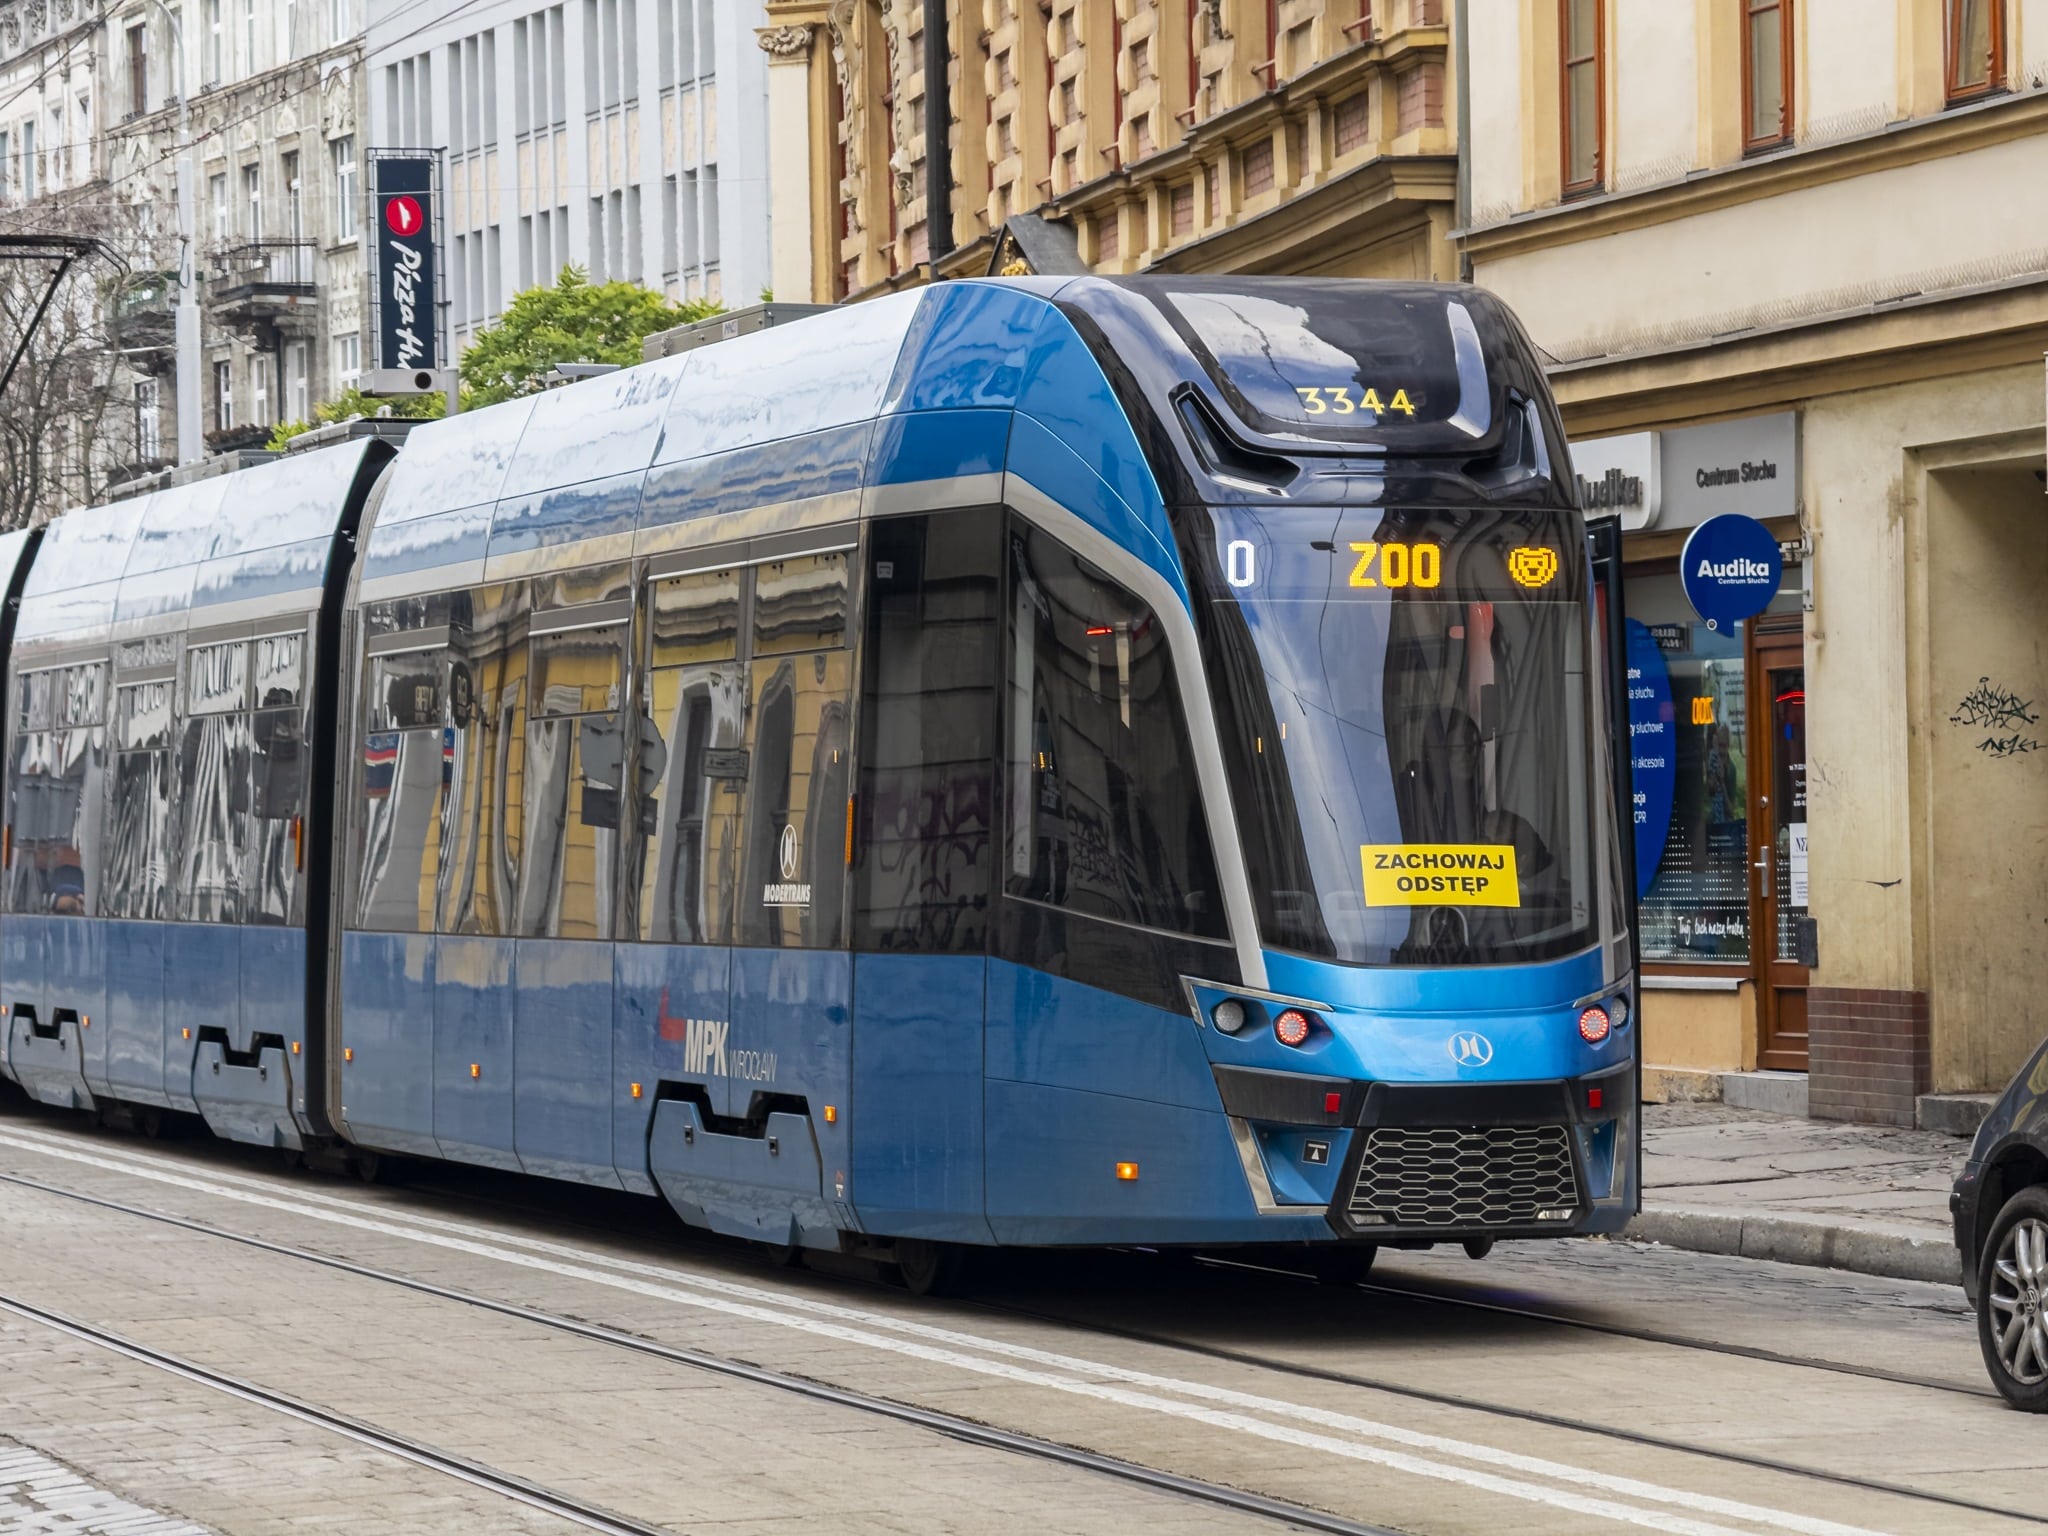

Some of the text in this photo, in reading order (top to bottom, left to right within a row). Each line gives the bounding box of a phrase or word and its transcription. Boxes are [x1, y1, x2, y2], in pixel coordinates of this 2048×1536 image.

[389, 240, 422, 325] Pizza
[1296, 387, 1416, 415] 3344
[1695, 459, 1777, 489] Centrum Słuchu
[1349, 542, 1441, 588] ZOO
[1697, 557, 1770, 578] Audika
[1717, 576, 1770, 585] Centrum Słuchu
[1634, 685, 1655, 699] słuchu
[1635, 720, 1664, 734] słuchowe
[1637, 756, 1665, 768] akcesoria
[1374, 853, 1505, 870] ZACHOWAJ
[763, 884, 811, 902] MODERTRANS
[1396, 876, 1489, 896] ODSTĘP
[684, 1018, 778, 1082] MPK WROCŁAW
